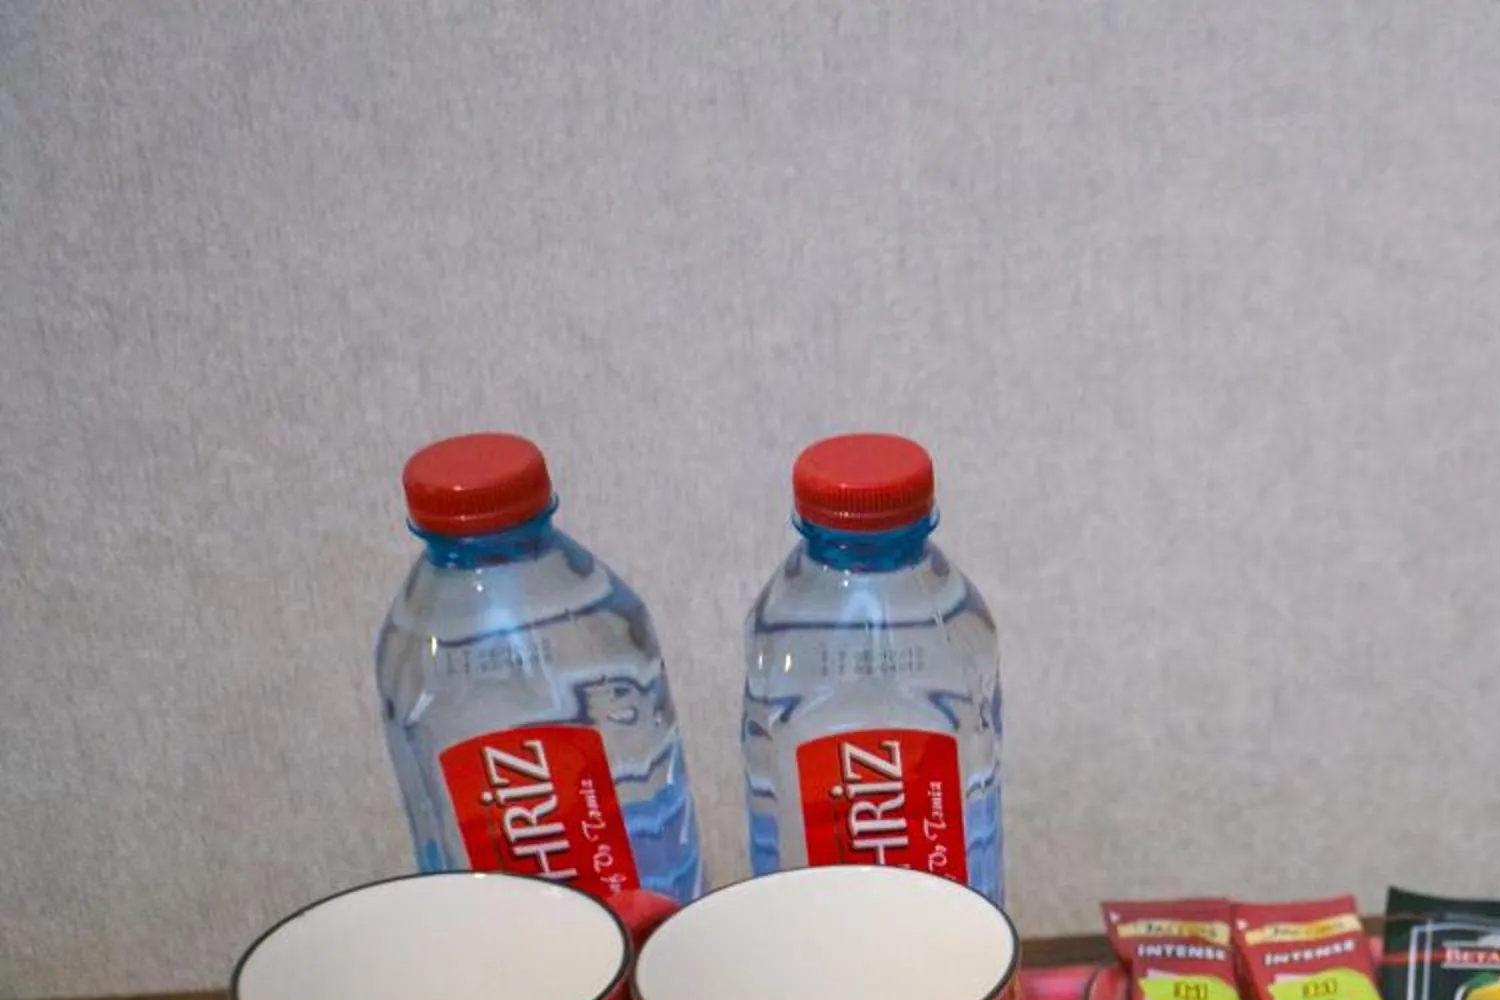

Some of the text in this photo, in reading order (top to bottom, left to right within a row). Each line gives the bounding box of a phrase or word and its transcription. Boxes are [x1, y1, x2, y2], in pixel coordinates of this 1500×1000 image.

[480, 739, 578, 881] HRİZ
[1136, 942, 1227, 961] INTENSE
[1264, 940, 1357, 967] INTENSE
